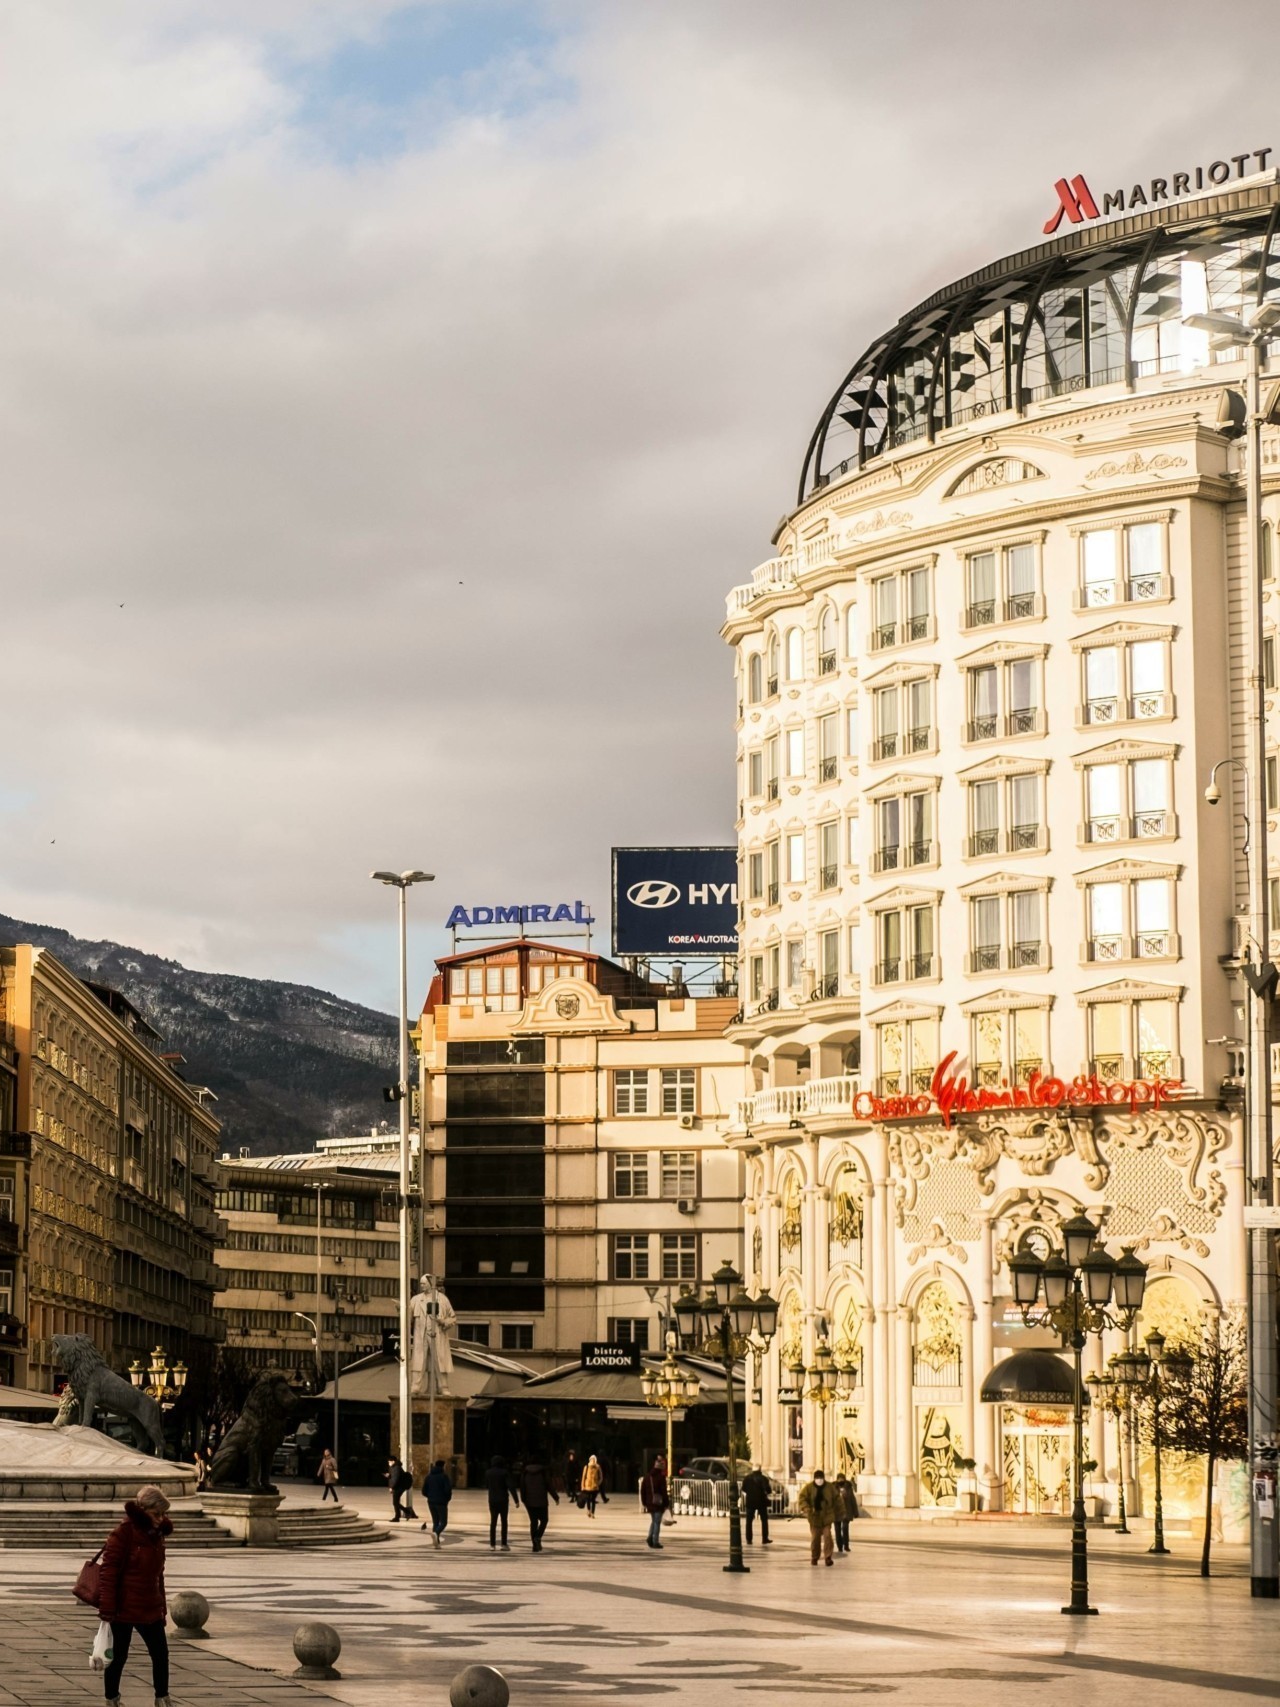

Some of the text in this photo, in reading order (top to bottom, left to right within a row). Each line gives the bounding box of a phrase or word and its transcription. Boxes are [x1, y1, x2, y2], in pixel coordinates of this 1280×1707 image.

[1103, 147, 1272, 216] MARRIOTT
[445, 899, 595, 929] ADMIRAL
[852, 1088, 931, 1121] Casino
[1067, 1072, 1184, 1115] Skopje
[585, 1356, 632, 1366] LONDON
[594, 1347, 623, 1355] bistro
